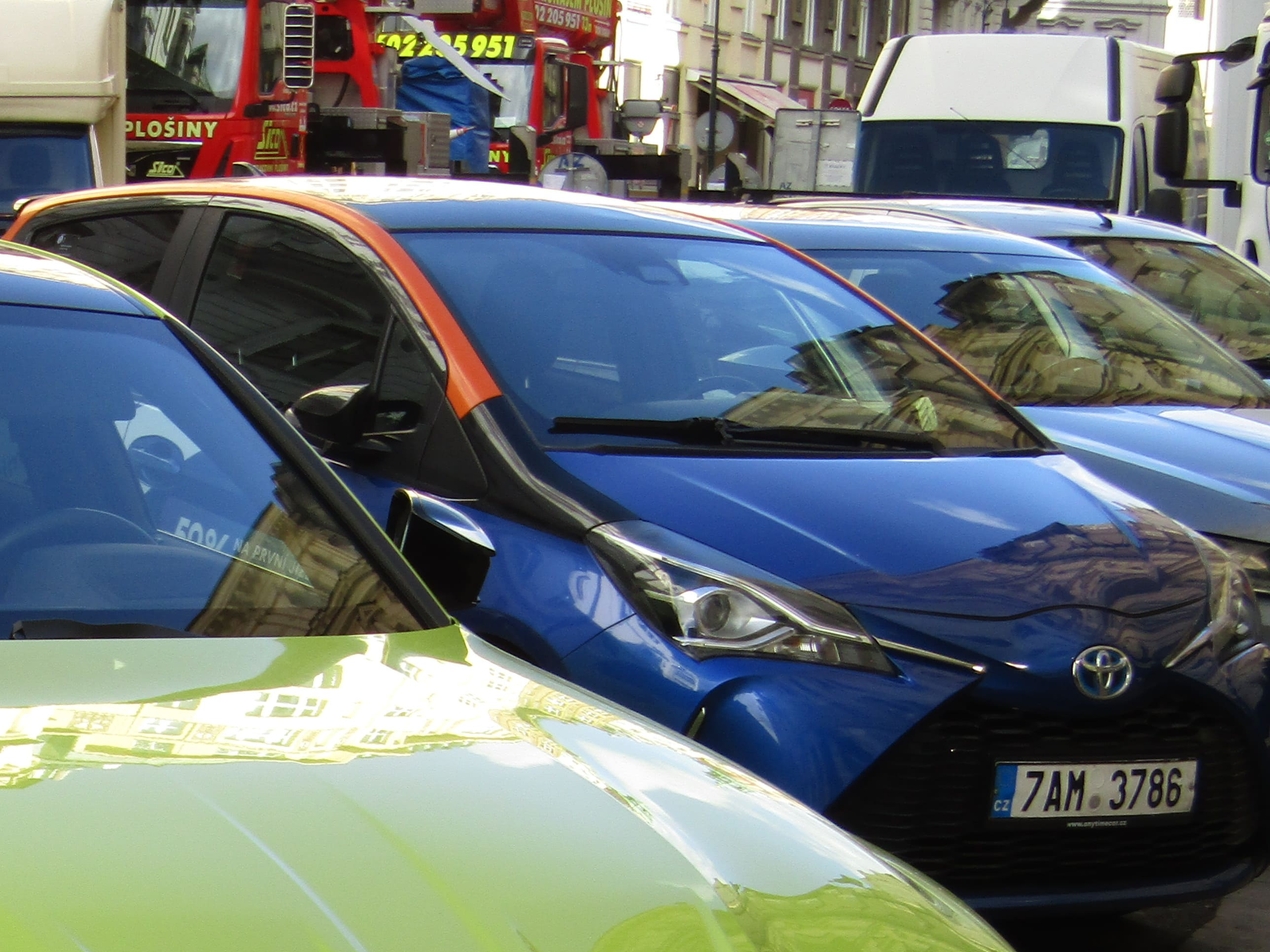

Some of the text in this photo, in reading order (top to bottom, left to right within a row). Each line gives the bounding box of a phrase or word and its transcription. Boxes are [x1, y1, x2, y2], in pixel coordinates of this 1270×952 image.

[470, 35, 515, 58] 951
[125, 116, 218, 139] PLOŠINY
[993, 767, 1183, 812] CZ 7AM 3786
